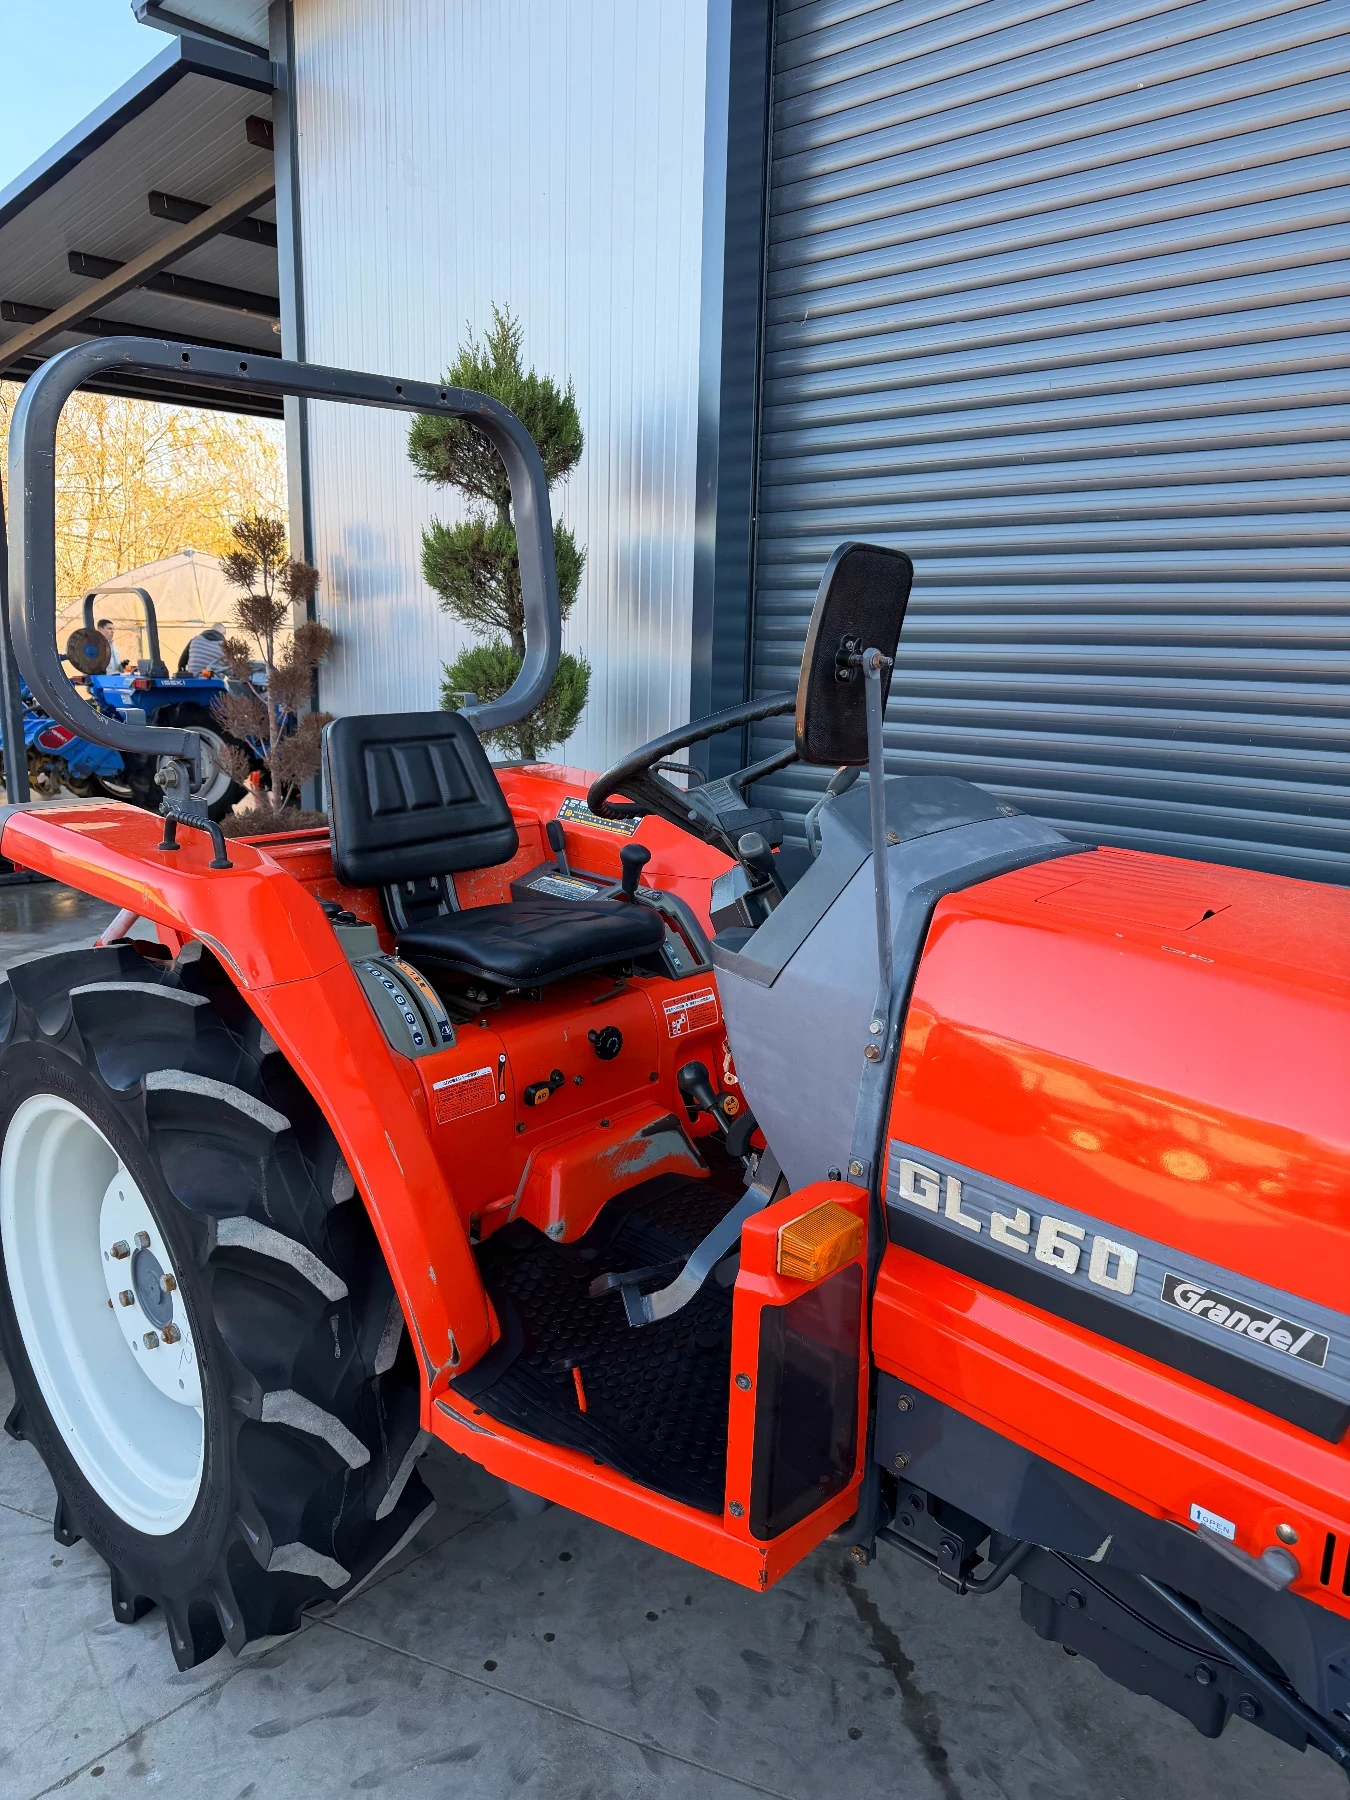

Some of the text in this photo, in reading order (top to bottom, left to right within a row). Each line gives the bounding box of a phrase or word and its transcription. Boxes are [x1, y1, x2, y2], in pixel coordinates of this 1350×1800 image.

[898, 1158, 1139, 1296] GL260
[1173, 1283, 1315, 1355] Grandel
[1202, 1516, 1230, 1534] OPEN
